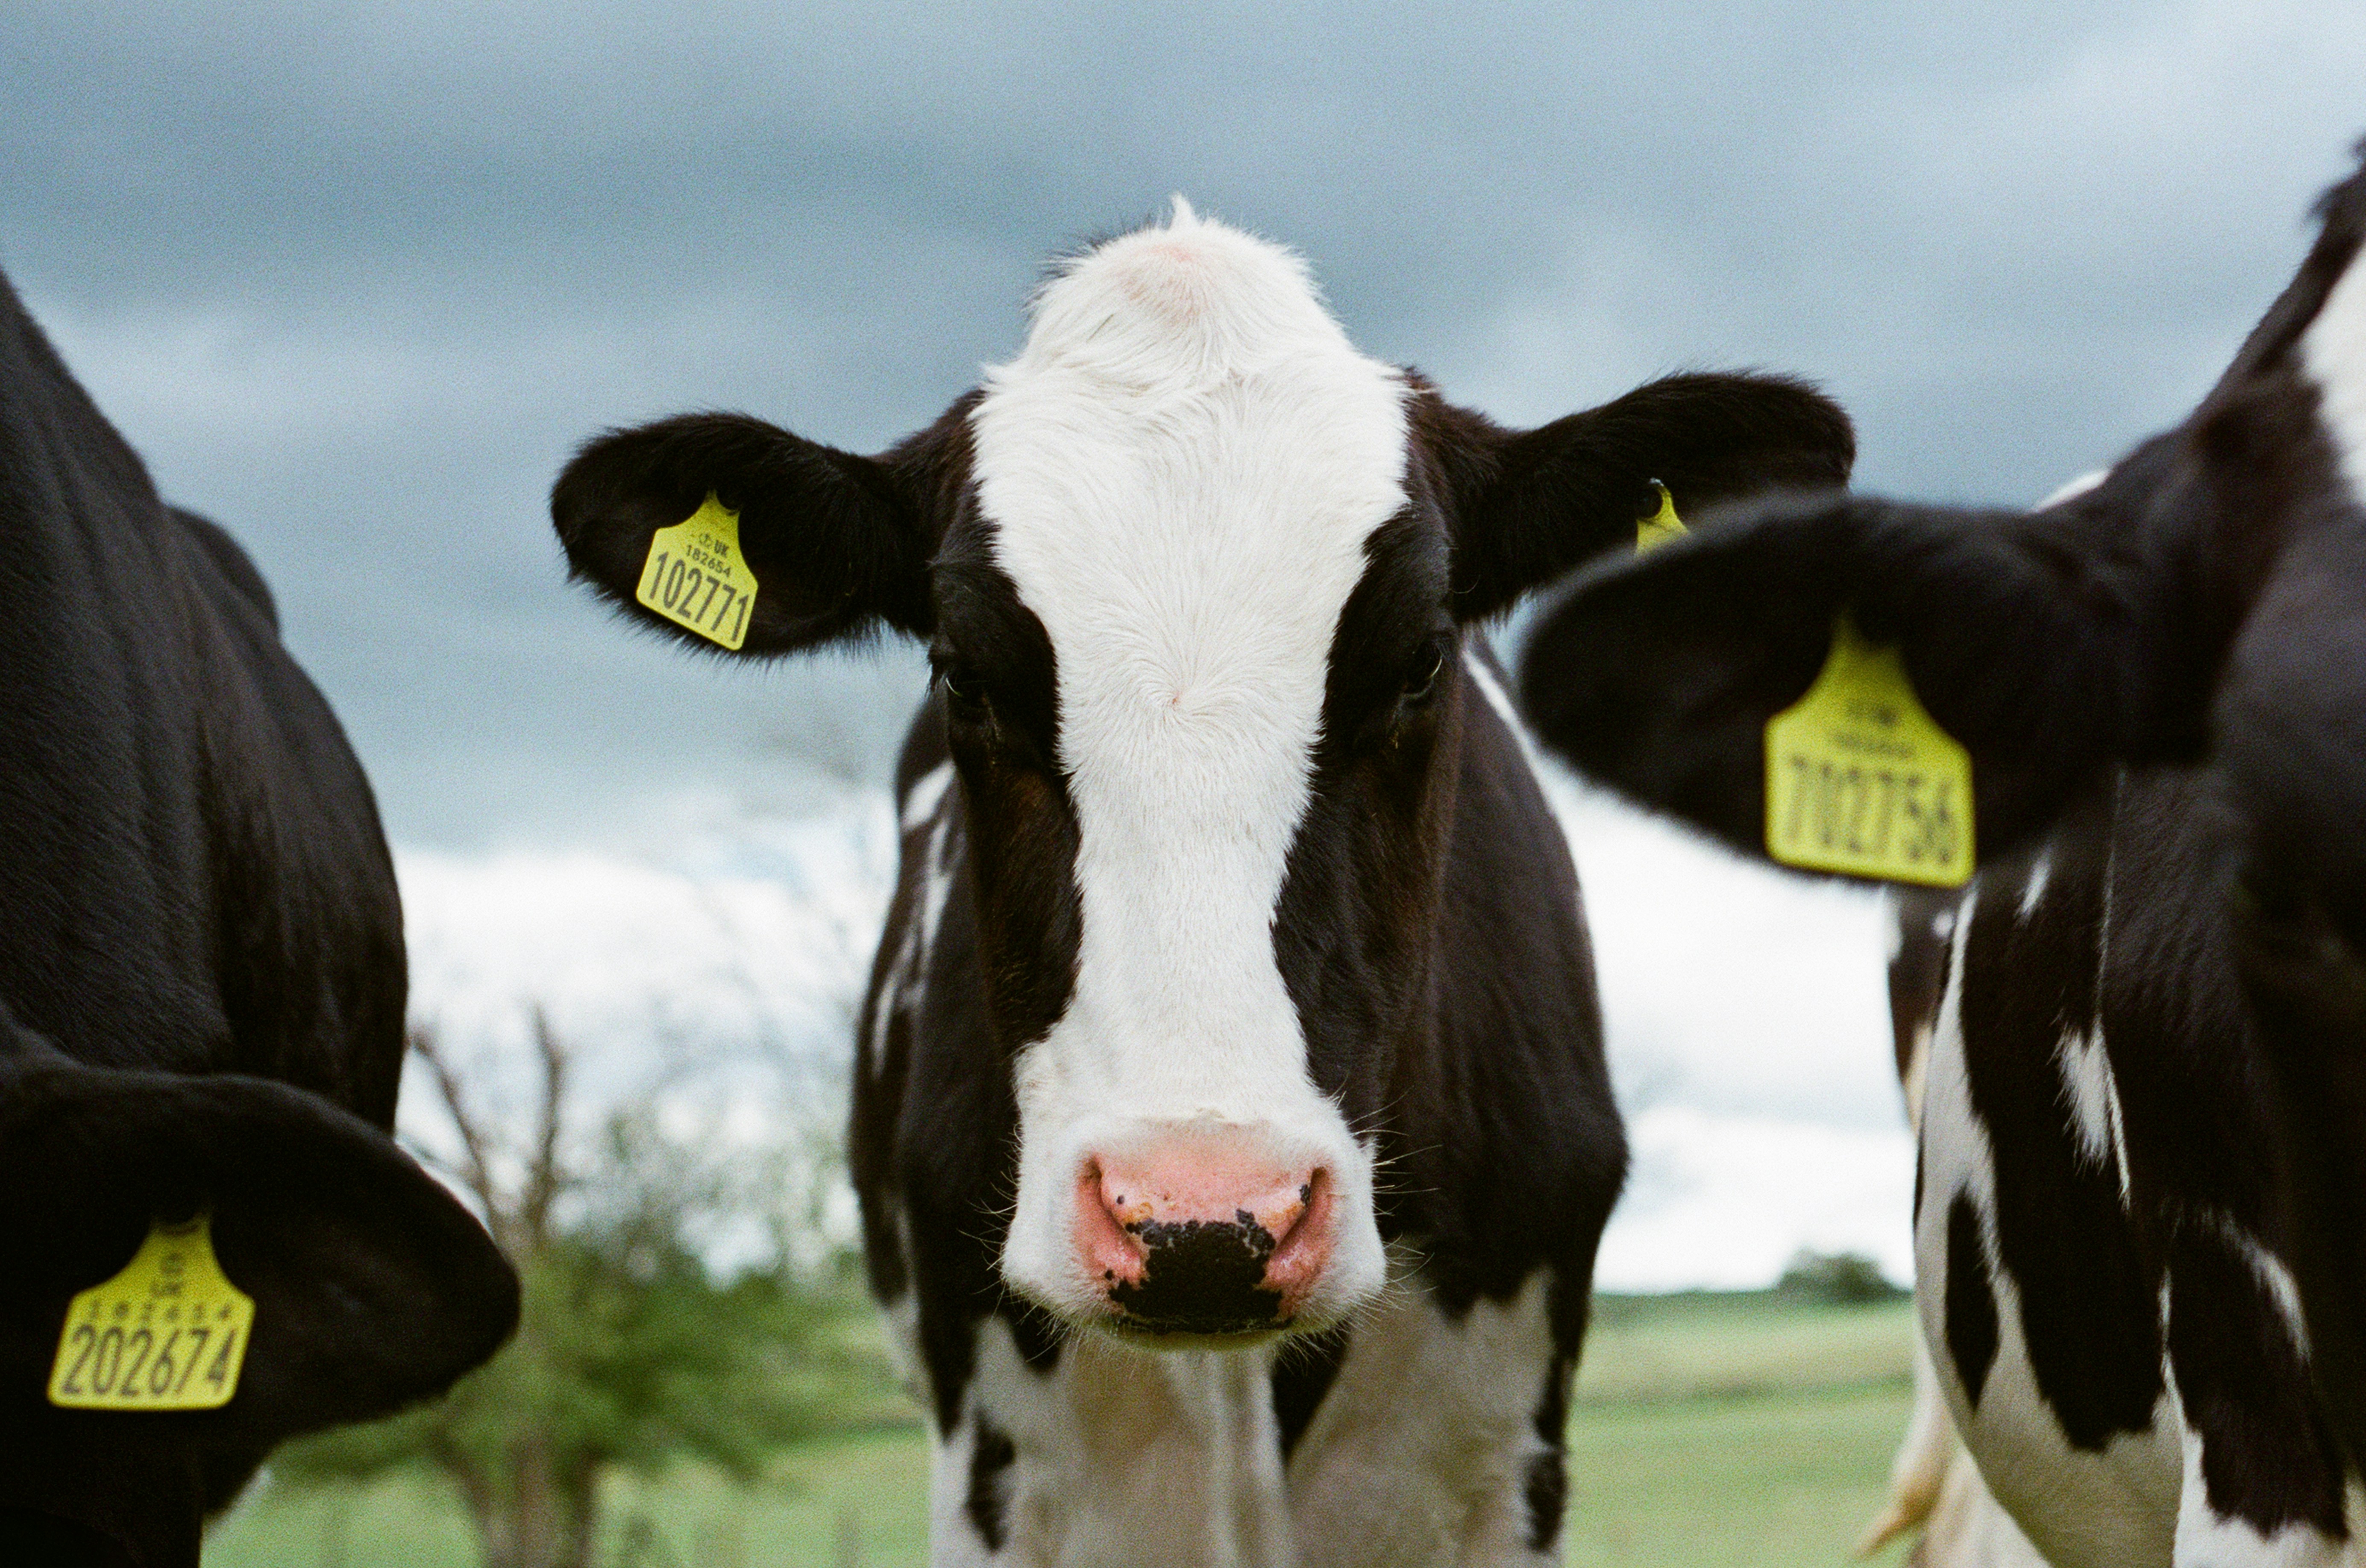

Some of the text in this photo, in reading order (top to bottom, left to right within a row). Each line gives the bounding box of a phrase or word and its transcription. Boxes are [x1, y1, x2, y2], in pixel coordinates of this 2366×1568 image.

[686, 544, 731, 578] 182654
[714, 539, 729, 558] UK
[649, 551, 749, 642] 102771
[63, 1323, 237, 1397] 202674
